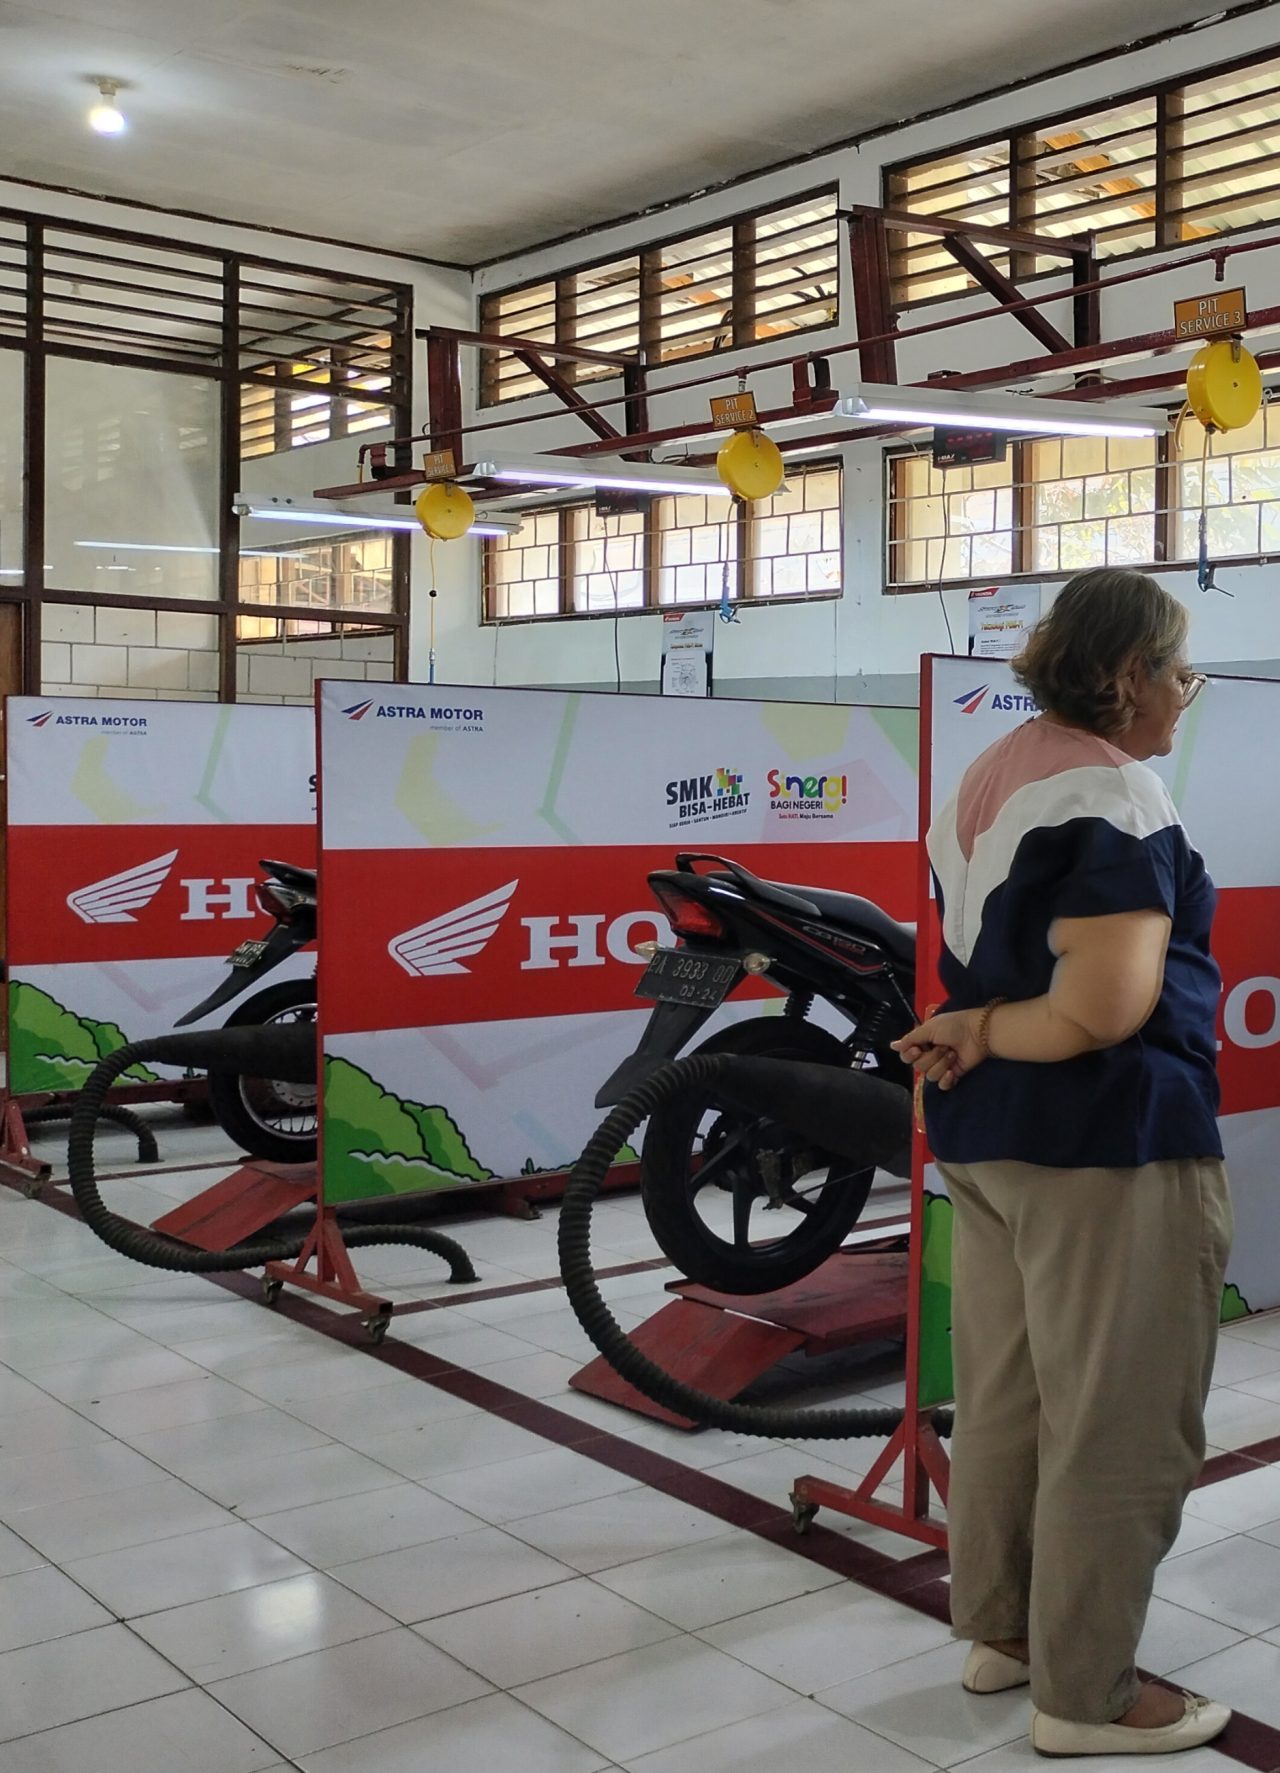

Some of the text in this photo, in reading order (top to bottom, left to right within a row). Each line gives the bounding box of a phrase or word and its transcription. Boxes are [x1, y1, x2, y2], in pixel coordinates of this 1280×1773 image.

[1199, 298, 1219, 316] PIT
[1180, 311, 1241, 335] SERVICE 3
[725, 398, 738, 410] PIT
[715, 410, 747, 425] SERVICE
[991, 694, 1038, 711] ASTR
[56, 715, 148, 727] ASTRA MOTOR
[376, 705, 484, 721] ASTRA MOTOR
[666, 775, 713, 806] SMK
[679, 793, 750, 818] BISA-HEBAT
[770, 800, 823, 810] BAGI NEGERI
[672, 958, 709, 980] 3933
